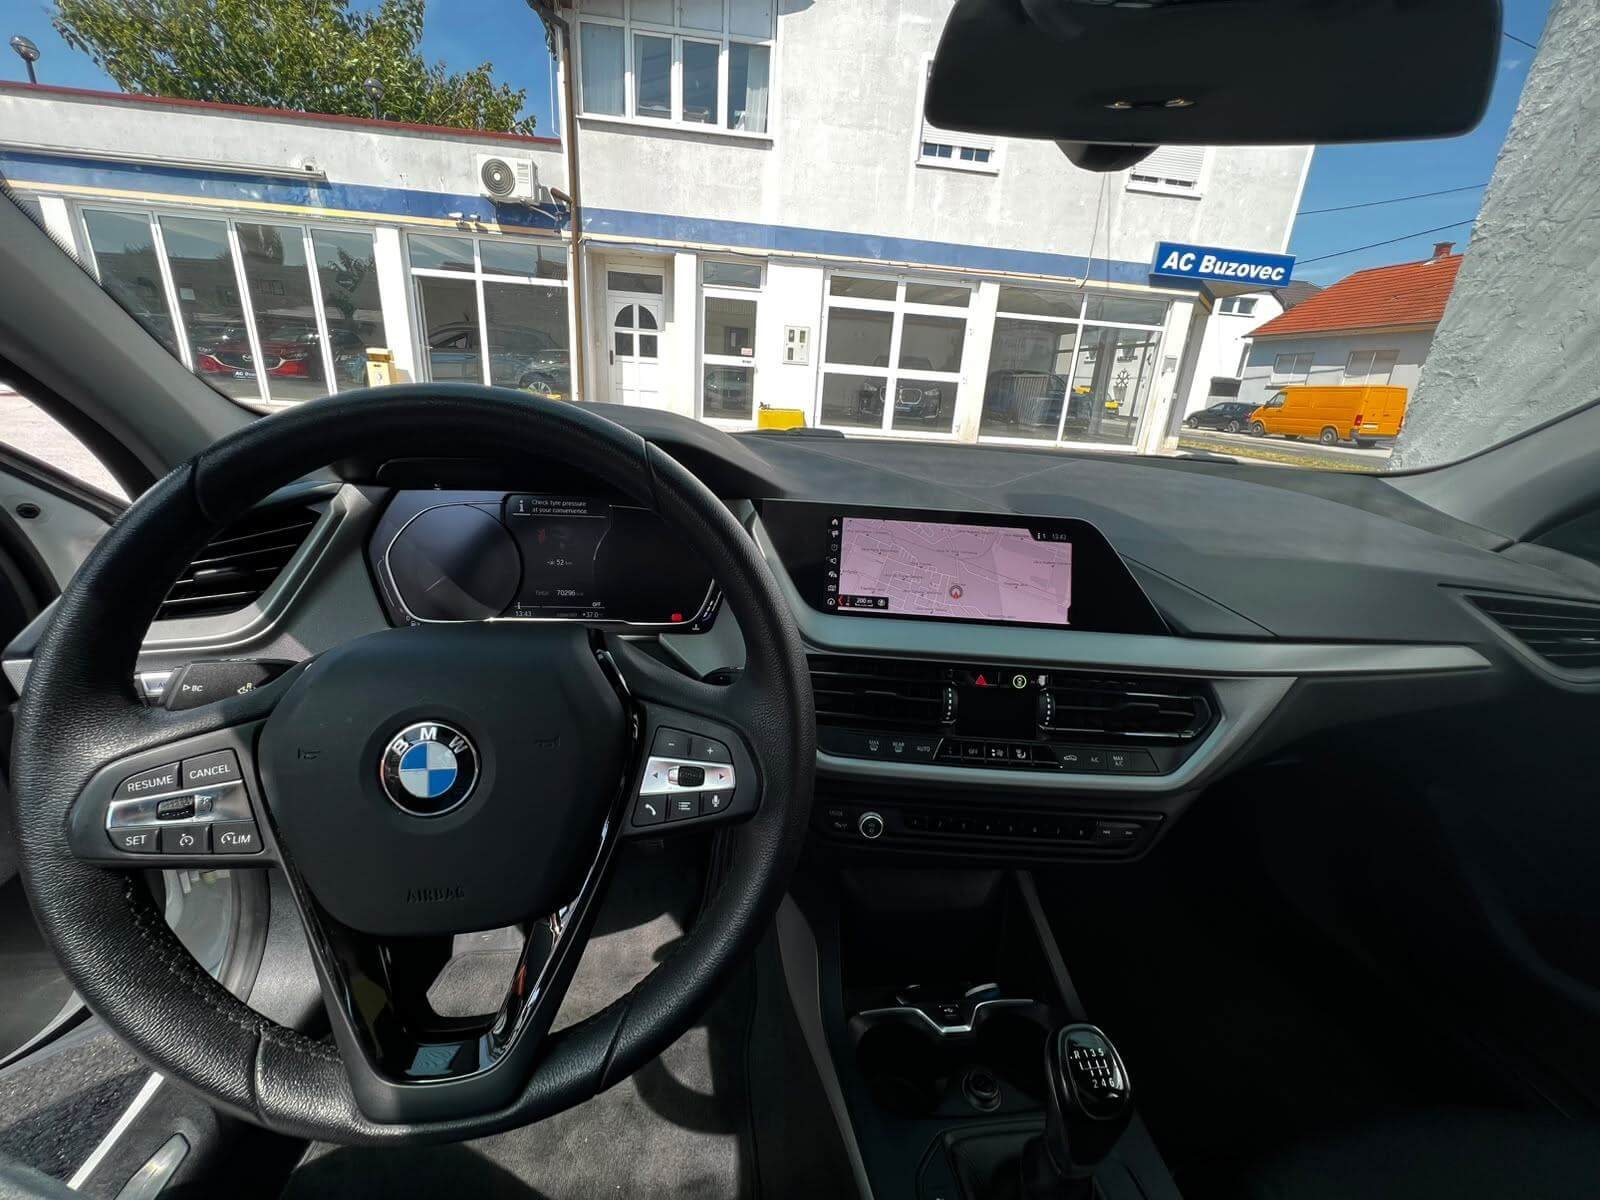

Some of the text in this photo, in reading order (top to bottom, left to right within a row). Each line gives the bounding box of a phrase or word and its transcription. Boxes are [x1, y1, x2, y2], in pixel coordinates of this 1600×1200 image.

[1162, 251, 1286, 281] AC Buzovec
[556, 589, 576, 597] 70296
[191, 684, 204, 692] BC
[391, 726, 469, 756] BMW
[189, 764, 231, 779] CANCEL
[127, 774, 174, 792] RESUME
[125, 834, 147, 846] SET
[232, 834, 251, 845] LIM
[407, 886, 465, 904] AIRBAG
